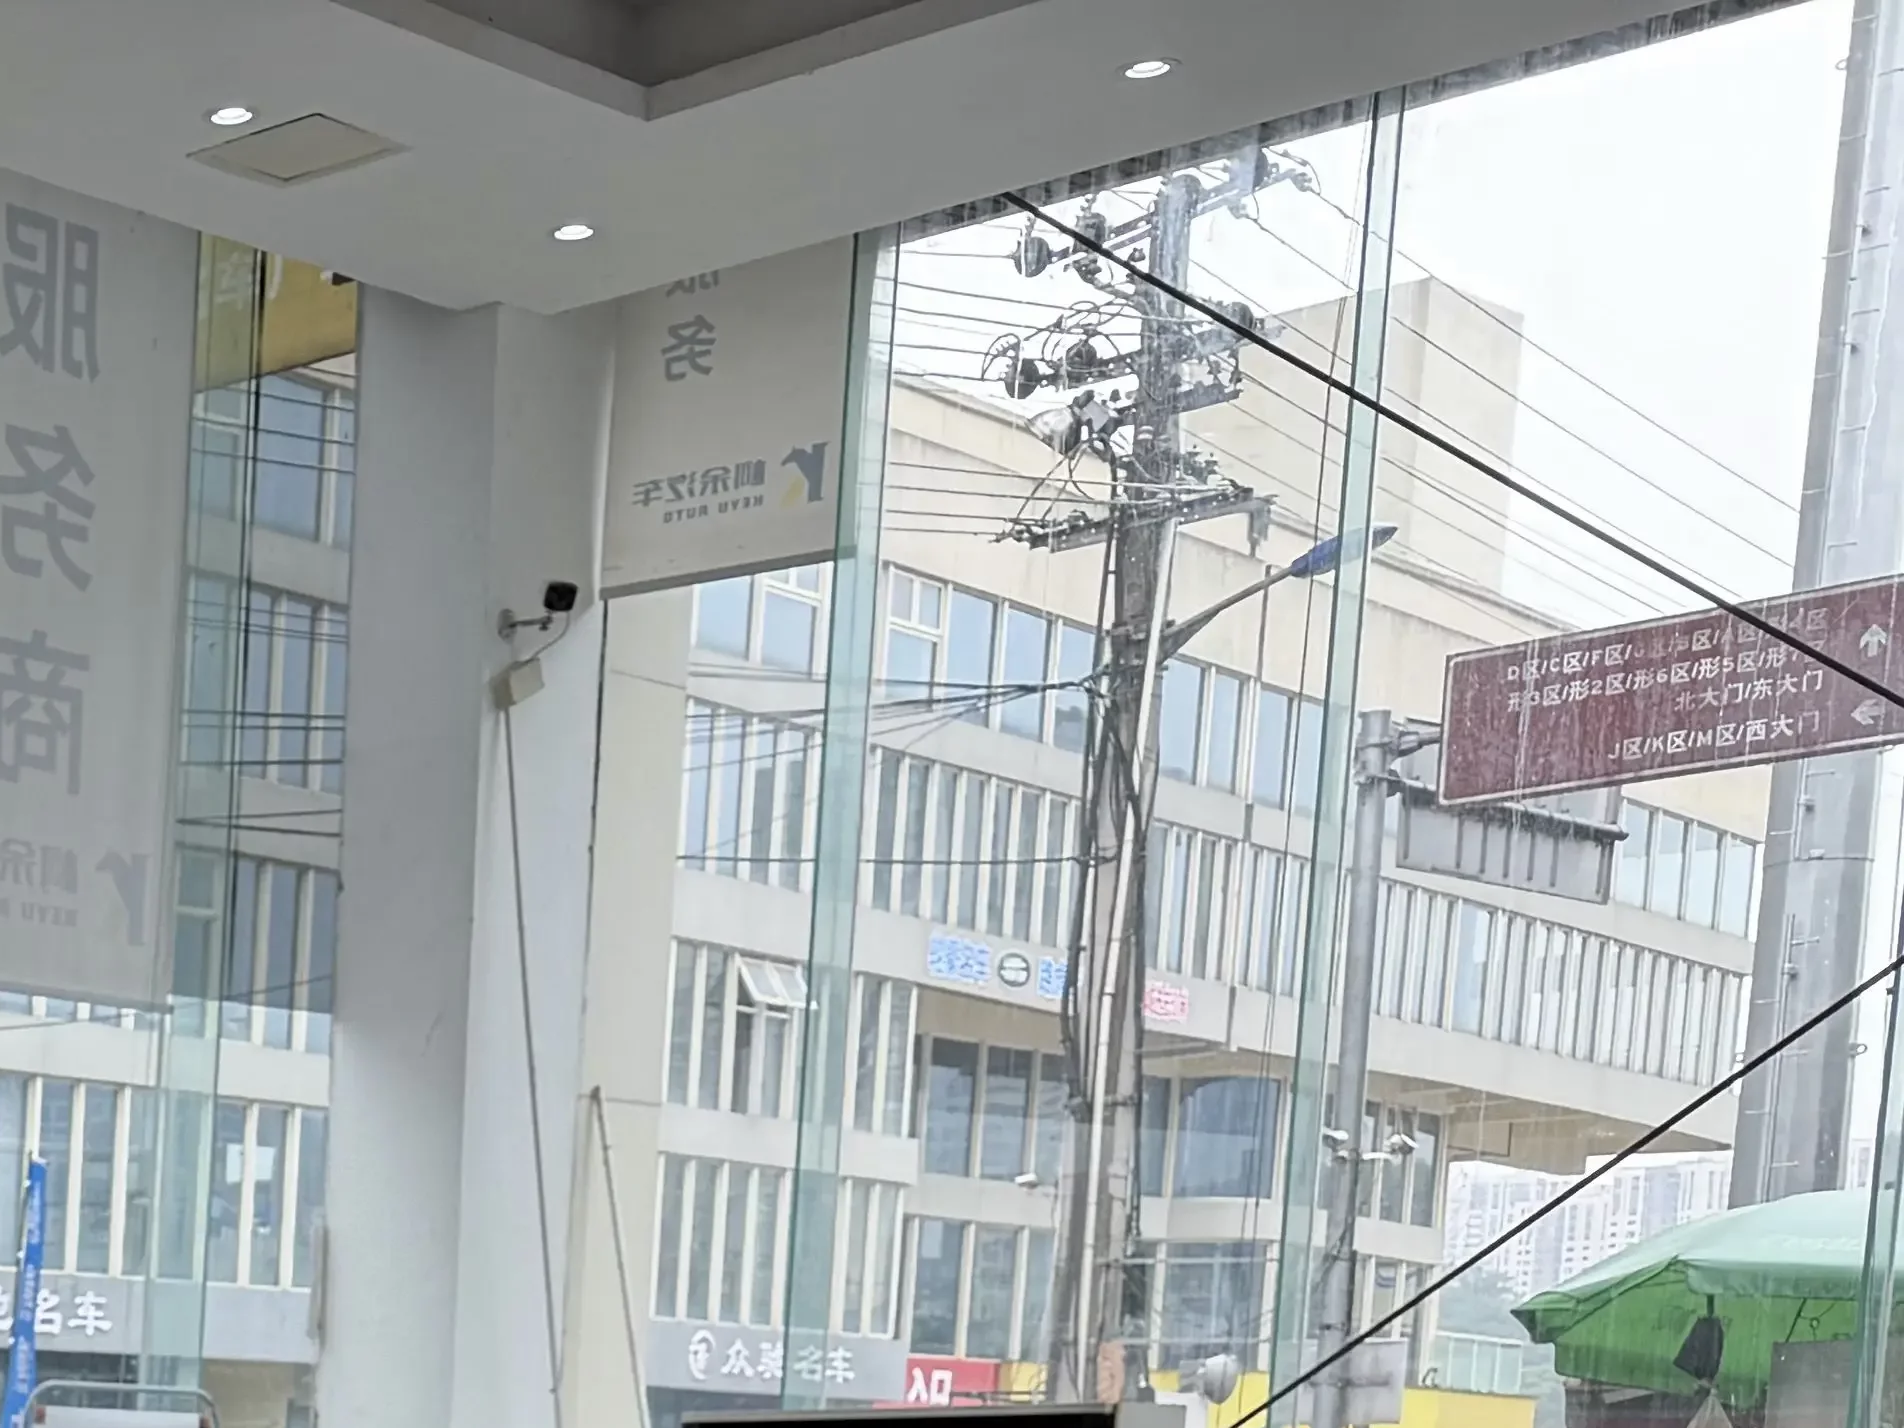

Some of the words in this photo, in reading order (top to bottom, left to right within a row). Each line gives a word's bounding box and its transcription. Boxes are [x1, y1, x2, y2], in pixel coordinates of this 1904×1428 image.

[1674, 669, 1824, 712] 北大门/东大门
[1607, 710, 1820, 761] J区/K区/M区/西大门
